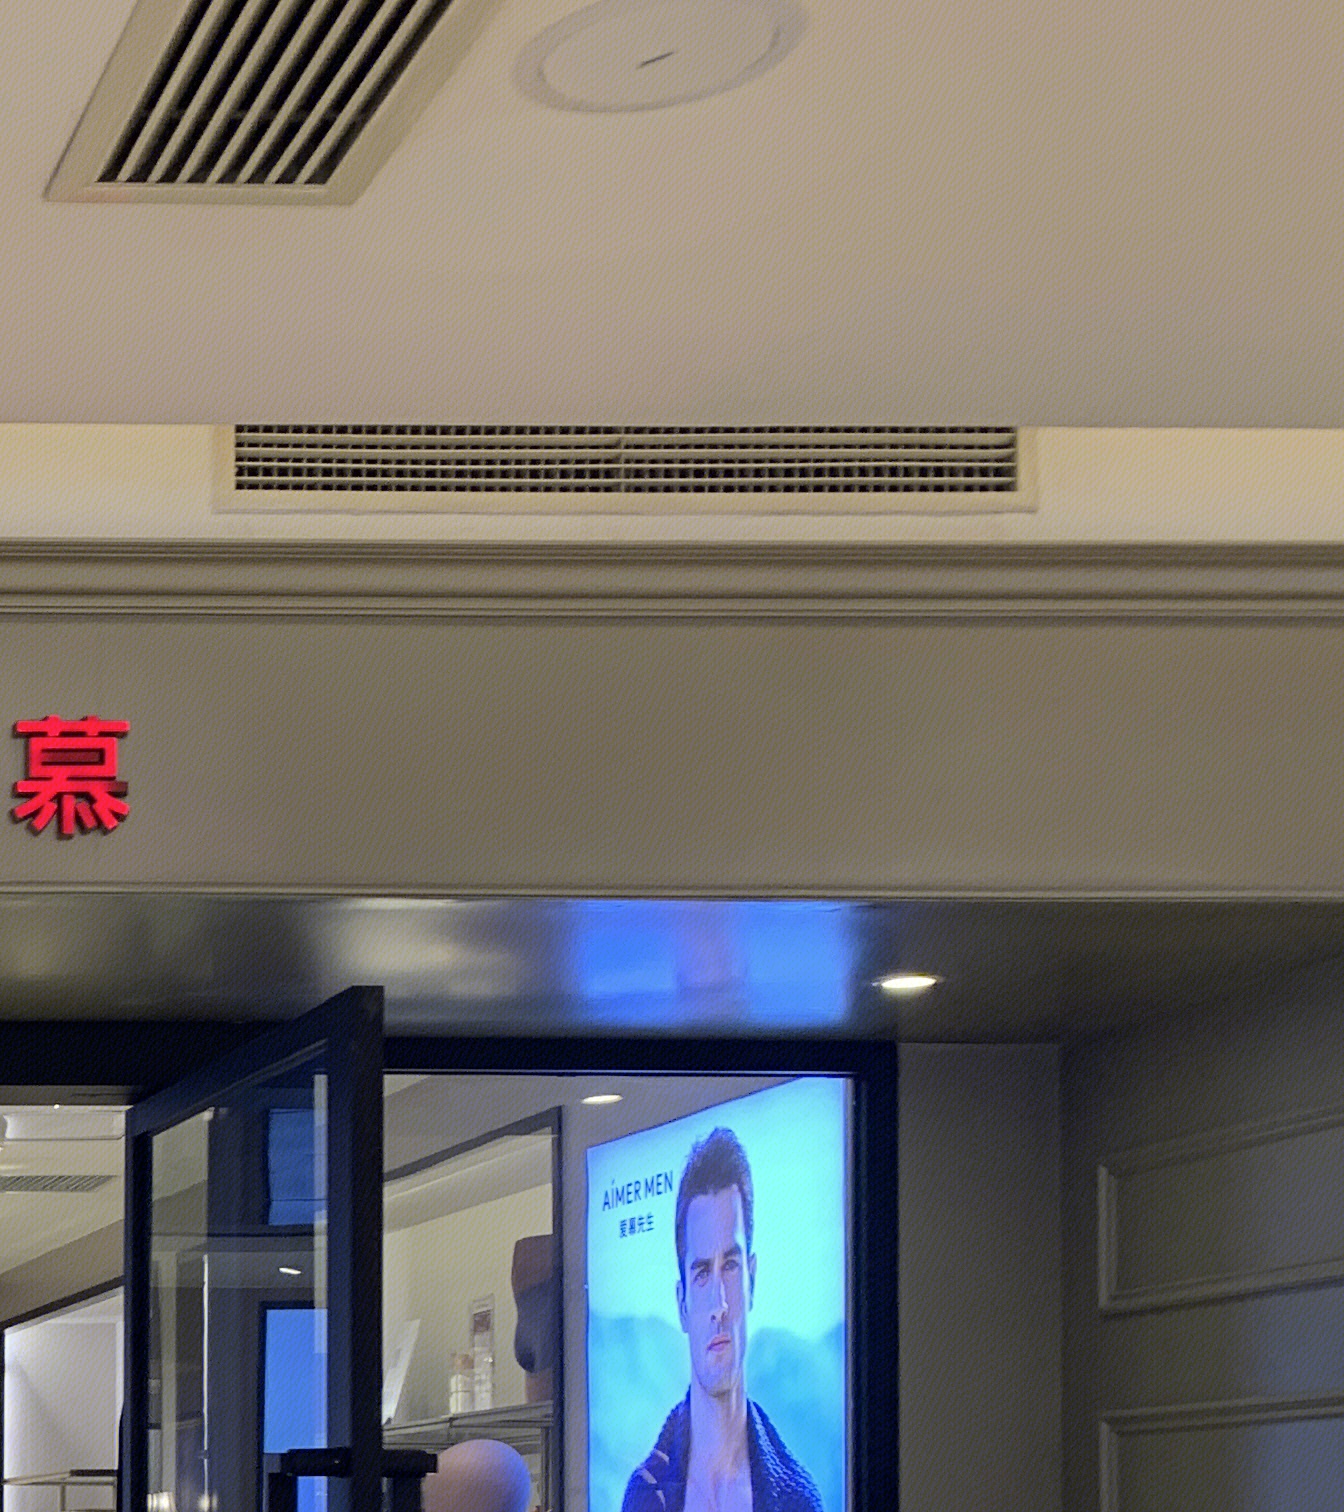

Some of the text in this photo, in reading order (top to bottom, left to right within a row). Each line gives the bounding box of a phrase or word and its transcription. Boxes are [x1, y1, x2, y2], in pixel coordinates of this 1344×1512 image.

[645, 1170, 674, 1199] MEN
[619, 1212, 655, 1239] 爱慕先生
